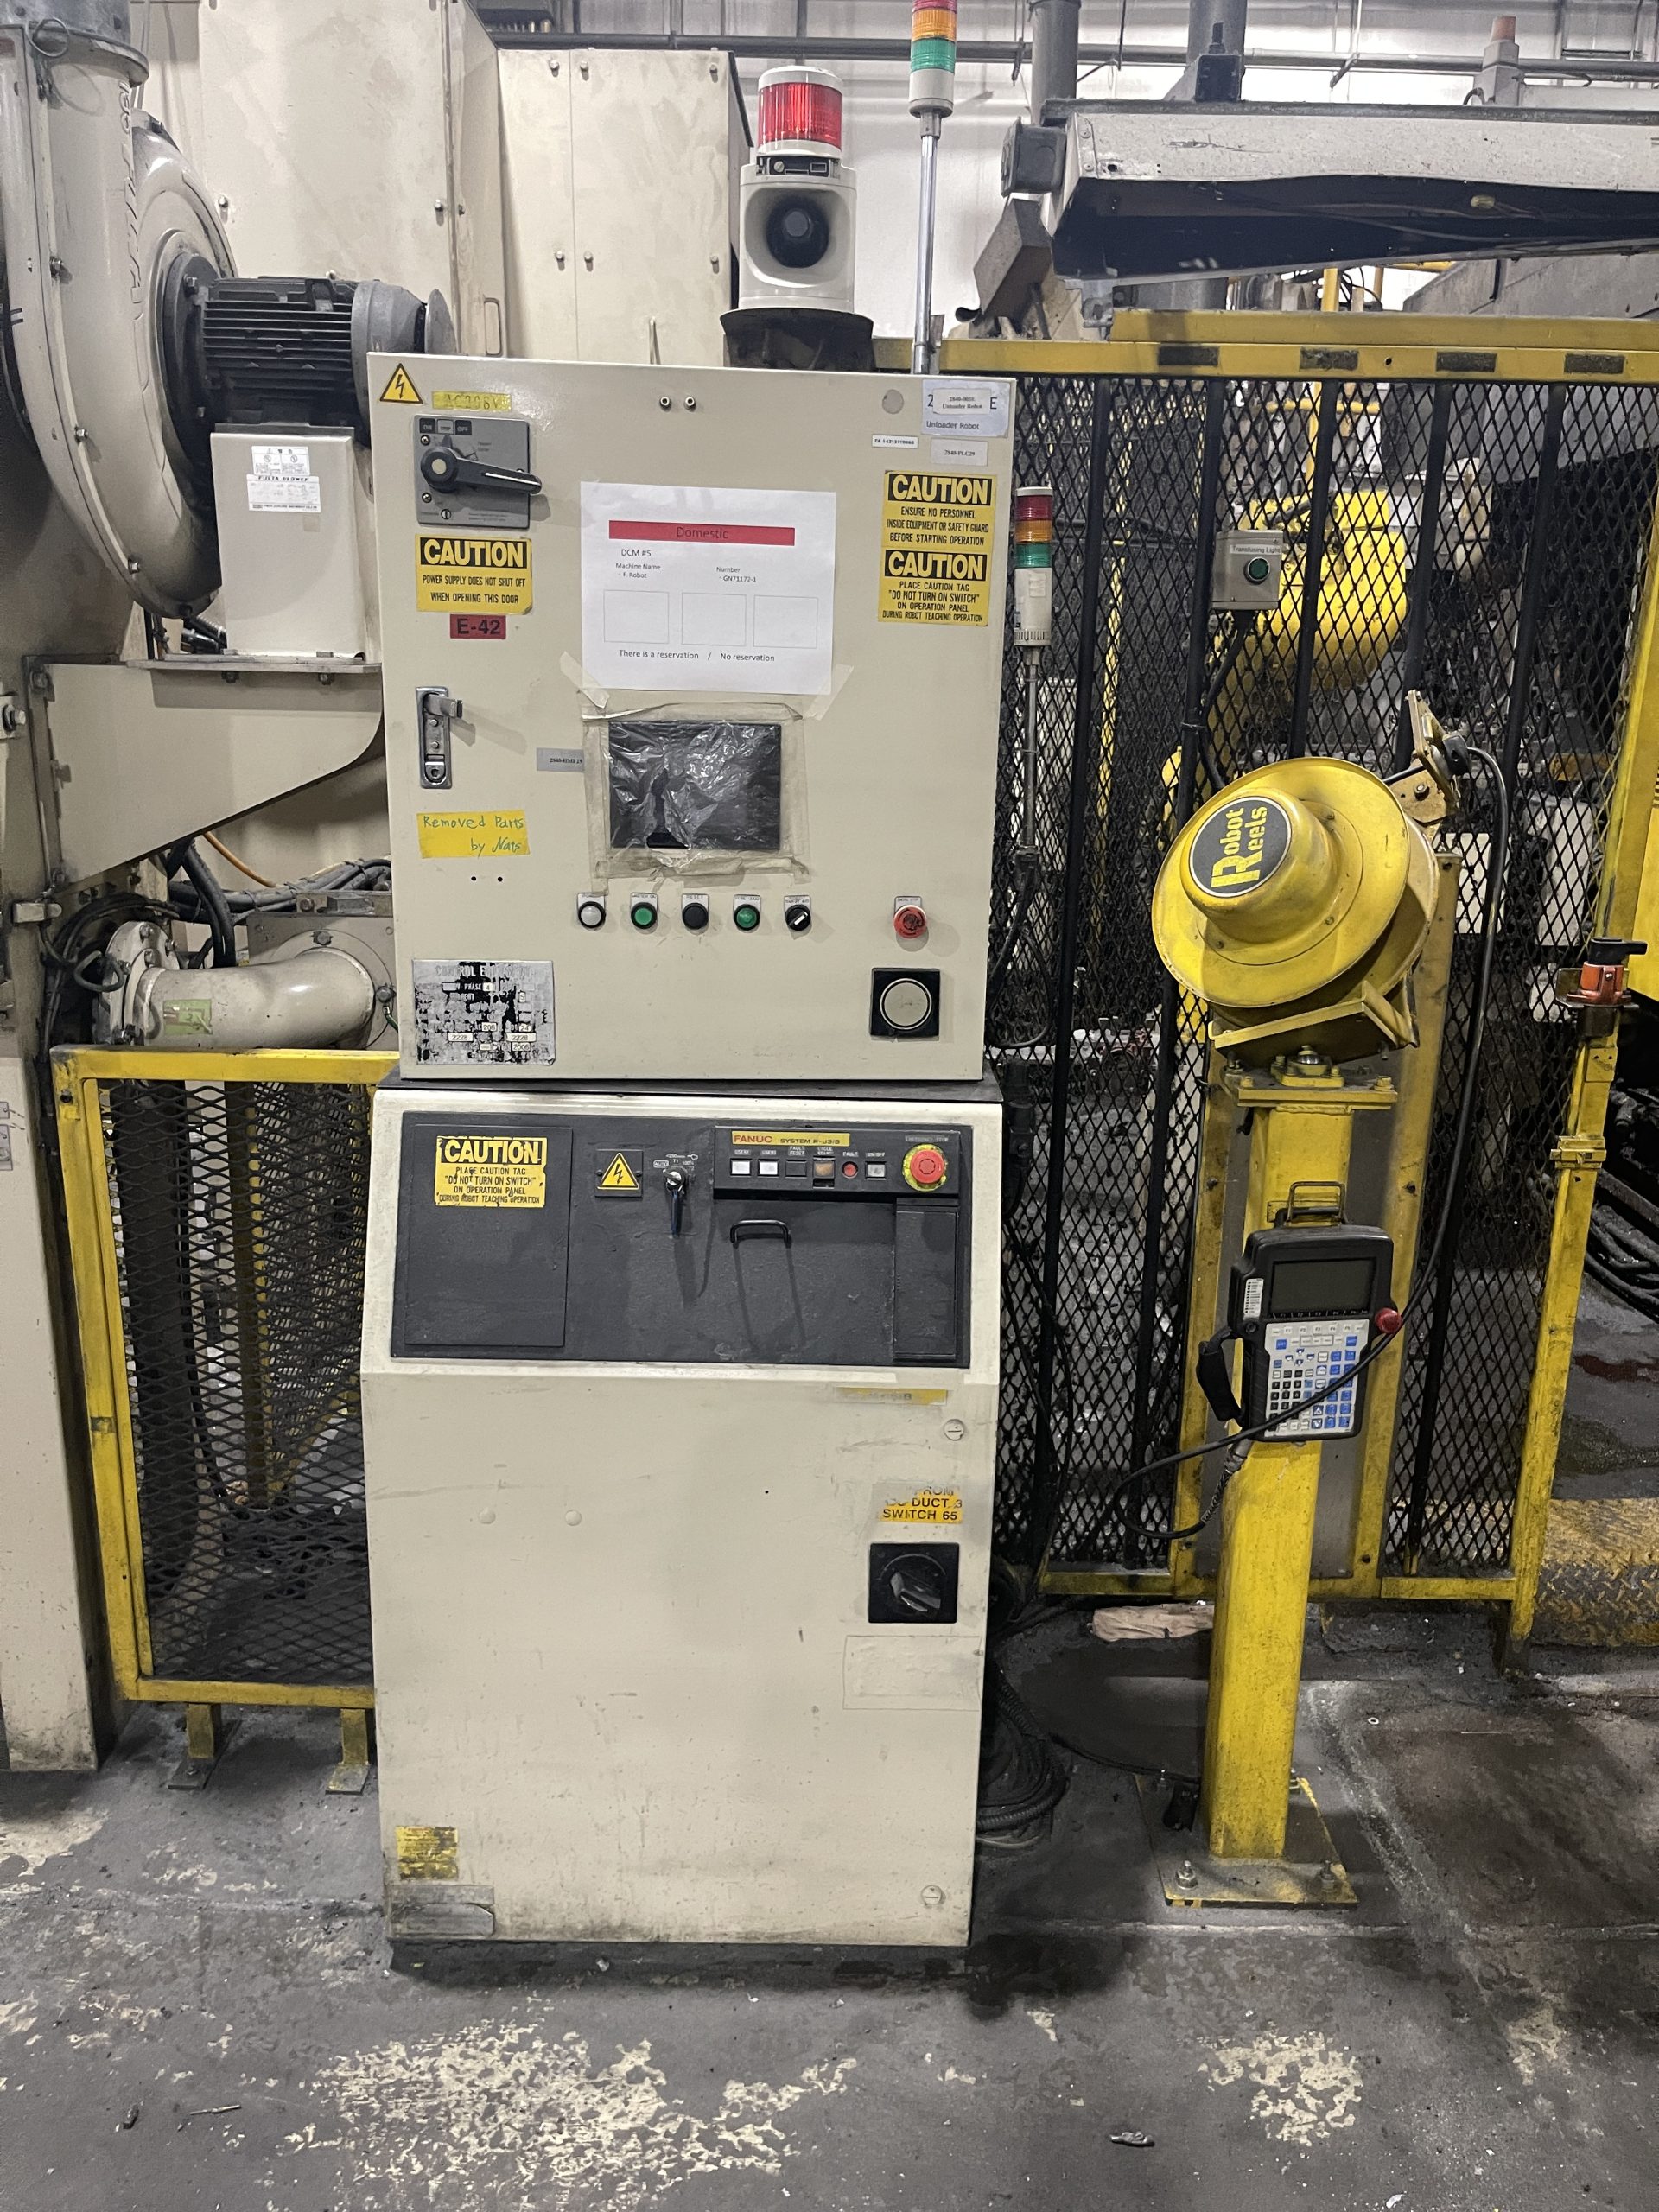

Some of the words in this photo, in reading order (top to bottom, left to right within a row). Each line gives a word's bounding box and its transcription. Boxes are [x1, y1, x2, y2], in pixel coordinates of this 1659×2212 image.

[926, 421, 957, 429] Unloader
[960, 422, 980, 430] Robot
[892, 474, 988, 505] CAUTION
[901, 506, 926, 516] ENSURE
[928, 508, 938, 517] NO
[939, 508, 976, 519] PERSONNEL
[887, 518, 905, 529] INSIDE
[906, 519, 938, 531] EQUIPMENT
[939, 521, 947, 531] OR
[948, 522, 969, 532] SAFETY
[970, 524, 989, 533] GUARD
[676, 526, 729, 539] Domestic
[890, 532, 913, 542] BEFORE
[916, 533, 948, 544] STARTING
[950, 535, 984, 546] OPERATION
[423, 538, 524, 568] CAUTION
[620, 549, 640, 557] DCM
[641, 549, 652, 557] #5
[888, 550, 983, 580] CAUTION
[423, 575, 442, 584] POWER
[444, 575, 467, 585] SUPPLY
[467, 576, 483, 586] DOES
[484, 577, 497, 586] NOT
[498, 577, 513, 587] SHUT
[515, 578, 525, 587] OFF
[899, 581, 921, 589] PLACE
[924, 582, 954, 591] CAUTION
[957, 583, 970, 592] TAG
[430, 592, 449, 601] WHEN
[453, 593, 481, 602] OPENING
[484, 594, 499, 603] THIS
[501, 594, 518, 604] DOOR
[888, 589, 901, 600] "DO
[903, 590, 917, 601] NOT
[918, 591, 937, 601] TURN
[938, 592, 948, 602] ON
[950, 593, 980, 603] SWITCH"
[897, 601, 906, 610] ON
[909, 602, 946, 611] OPERATION
[949, 604, 969, 613] PANEL
[882, 610, 903, 619] DURING
[905, 611, 923, 620] ROBOT
[925, 612, 951, 621] TEACHING
[953, 613, 983, 622] OPERATION
[456, 618, 501, 634] E-42
[619, 649, 641, 658] There
[657, 651, 699, 659] reservation
[423, 815, 486, 830] Removed
[494, 816, 524, 830] Parts
[470, 837, 486, 859] by
[734, 1135, 773, 1143] FANUC
[444, 1139, 539, 1164] CAUTION
[444, 1175, 458, 1185] "DO
[459, 1175, 473, 1185] NOT
[474, 1176, 493, 1185] TURN
[494, 1176, 504, 1185] ON
[505, 1176, 537, 1186] SWITCH"
[466, 1185, 503, 1194] OPERATION
[505, 1186, 526, 1195] PANEL
[439, 1194, 460, 1203] DURING
[461, 1194, 479, 1203] ROBOT
[481, 1195, 508, 1204] TEACHING
[510, 1195, 540, 1204] OPERATION
[912, 1497, 950, 1508] DUCT
[882, 1508, 937, 1520] SWITCH
[942, 1510, 958, 1521] 65
